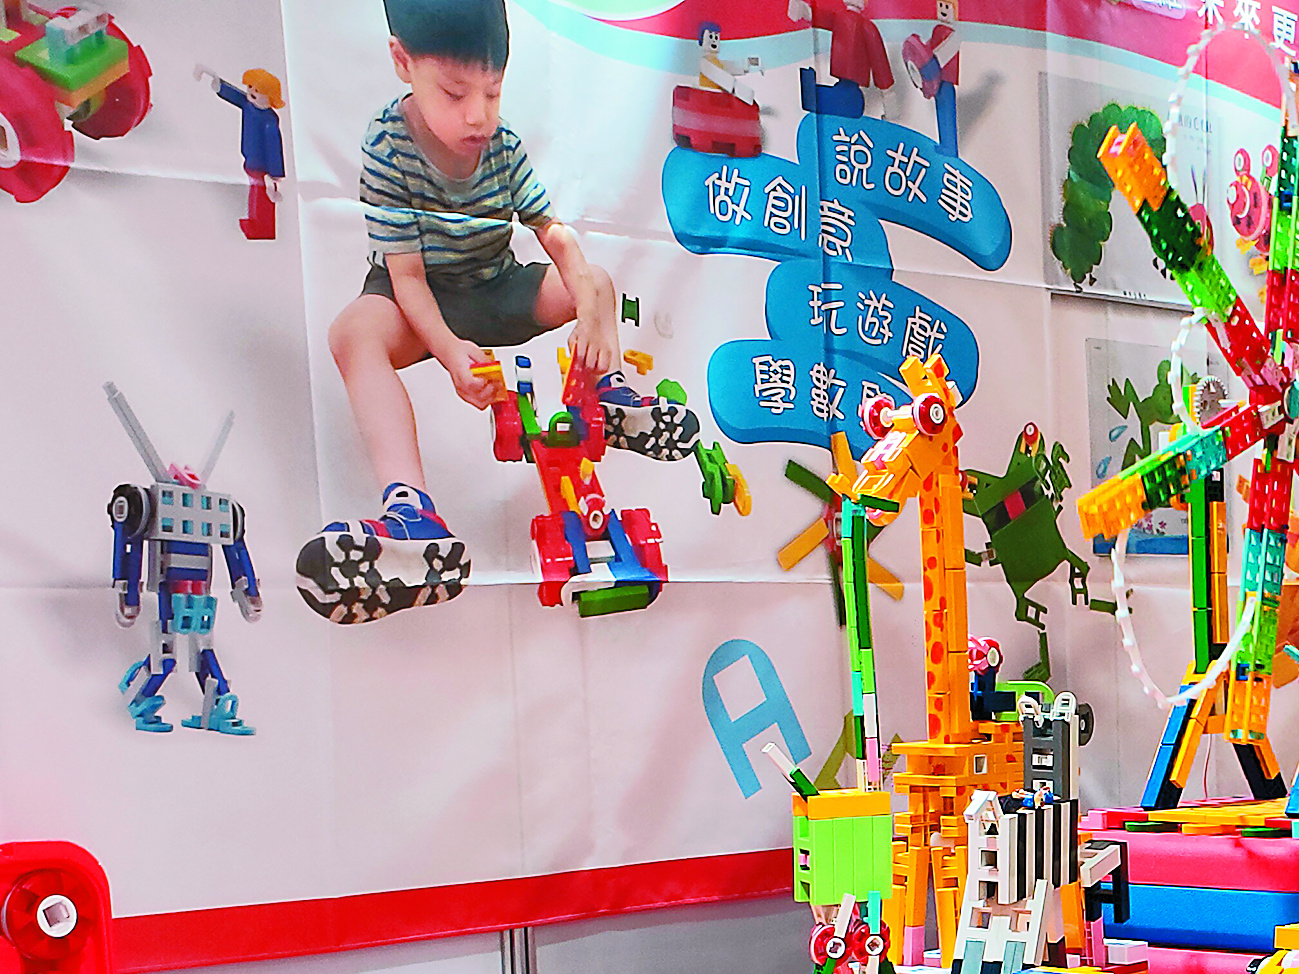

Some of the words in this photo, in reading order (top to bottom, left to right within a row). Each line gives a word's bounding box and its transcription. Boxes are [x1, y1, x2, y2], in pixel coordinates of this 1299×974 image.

[704, 165, 857, 263] 做創意
[832, 127, 975, 223] 說故事
